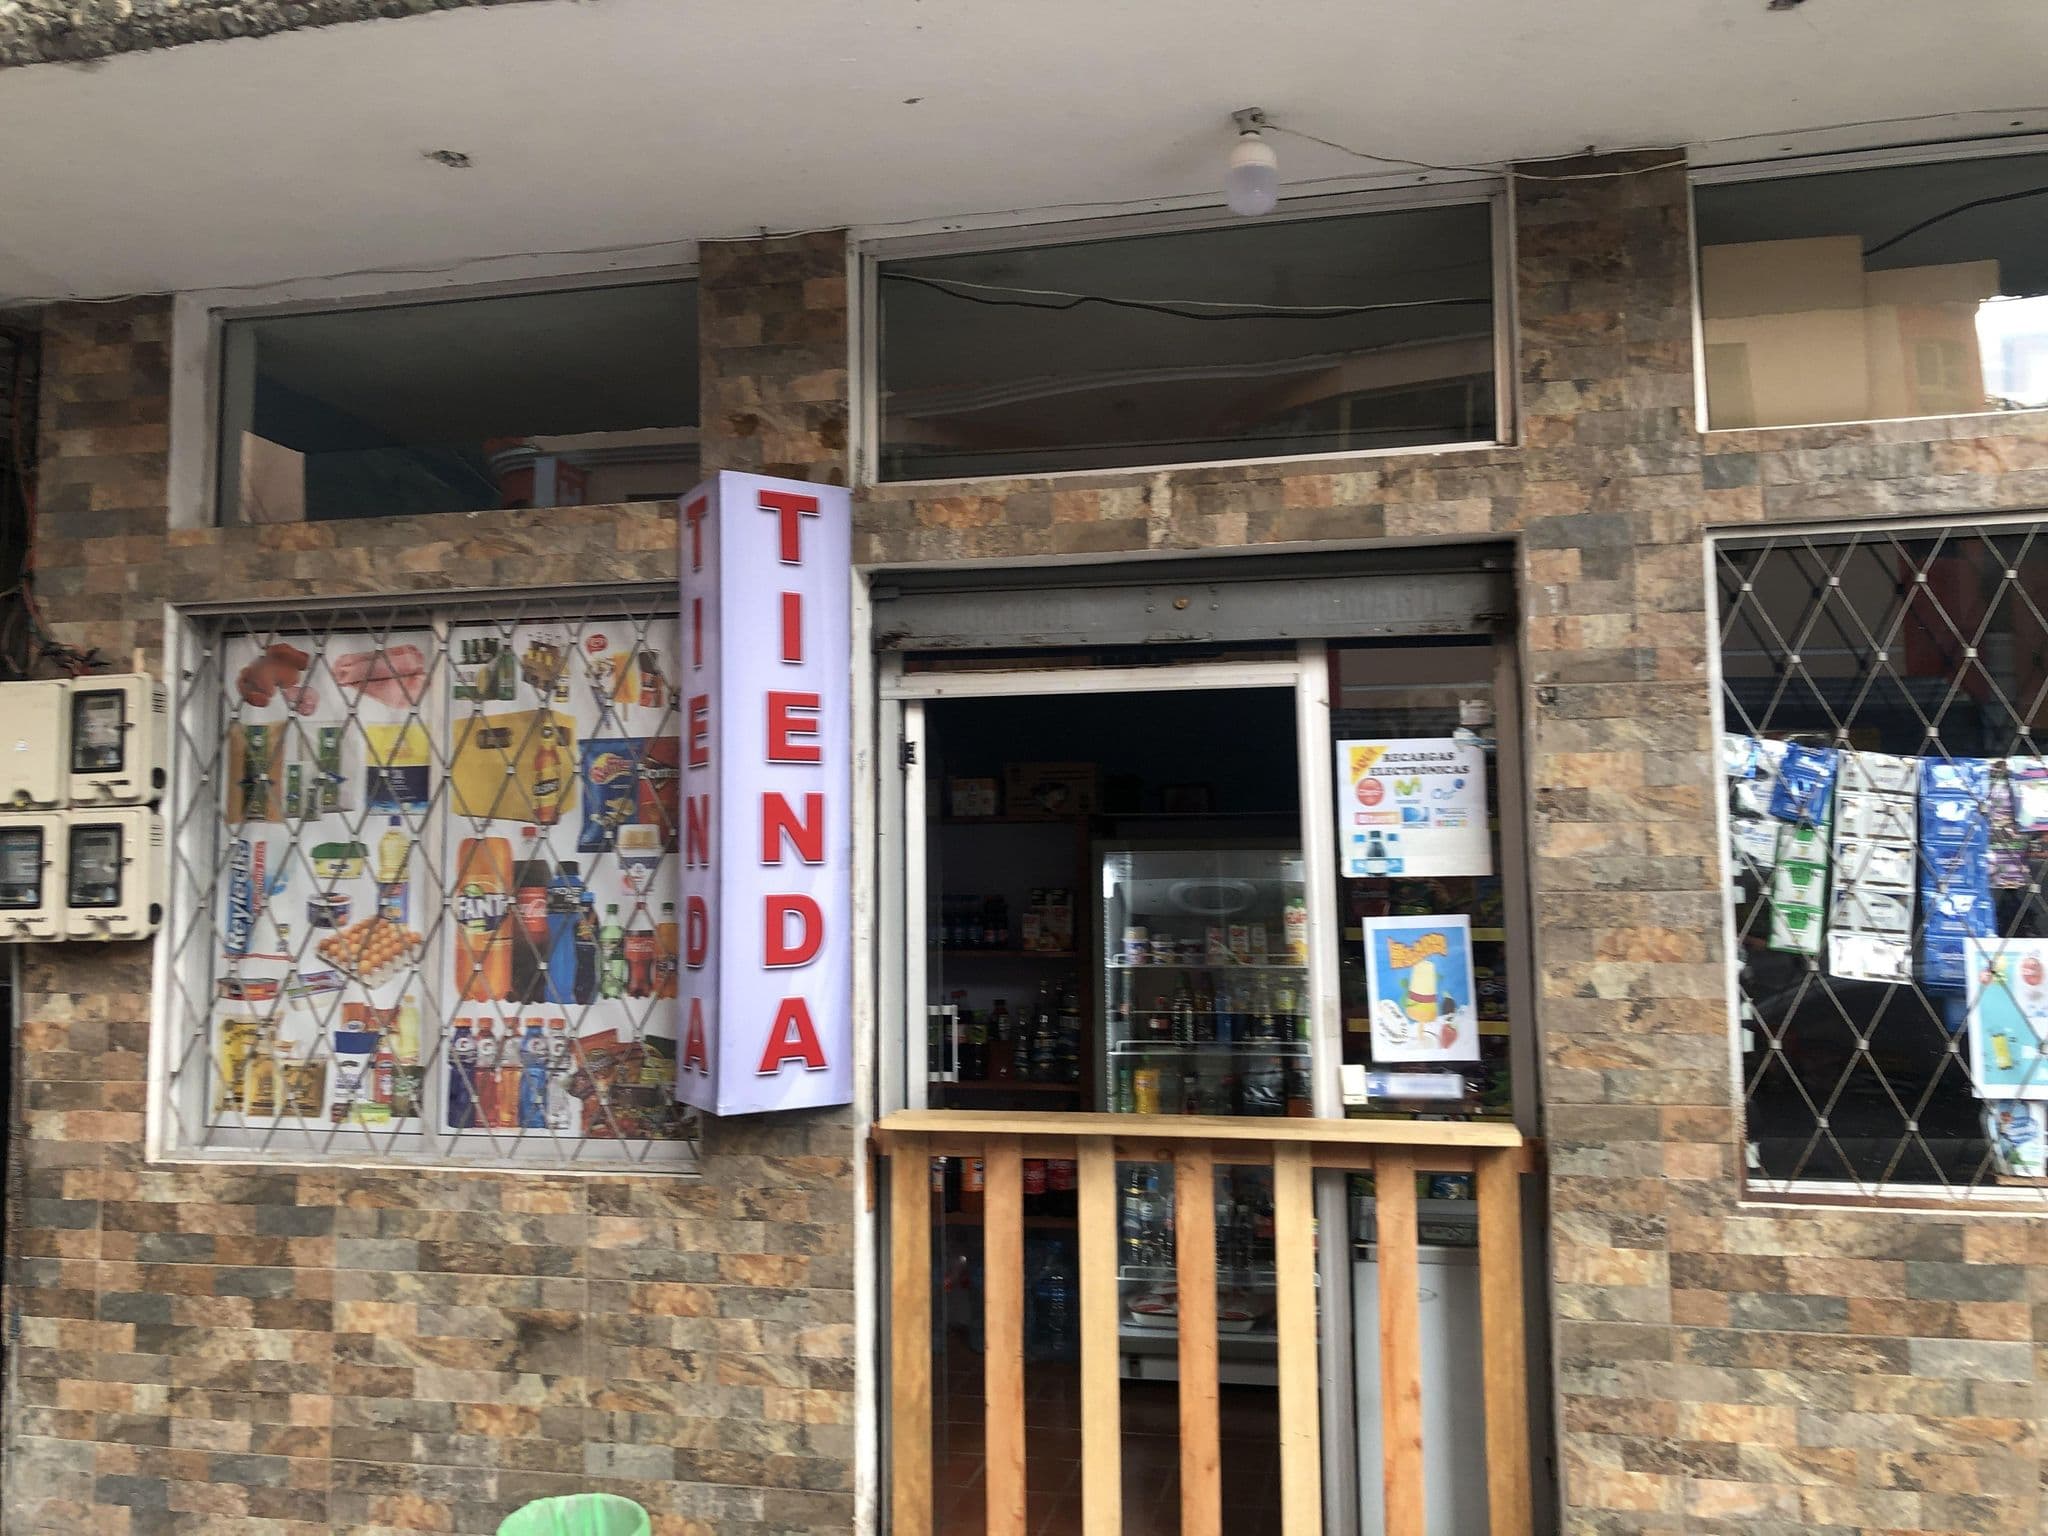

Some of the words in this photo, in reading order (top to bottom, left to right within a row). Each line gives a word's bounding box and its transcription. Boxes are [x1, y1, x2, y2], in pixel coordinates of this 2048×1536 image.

[683, 496, 710, 1075] TIENDA
[756, 489, 829, 1075] TIENDA
[1382, 752, 1455, 762] RECARGAS
